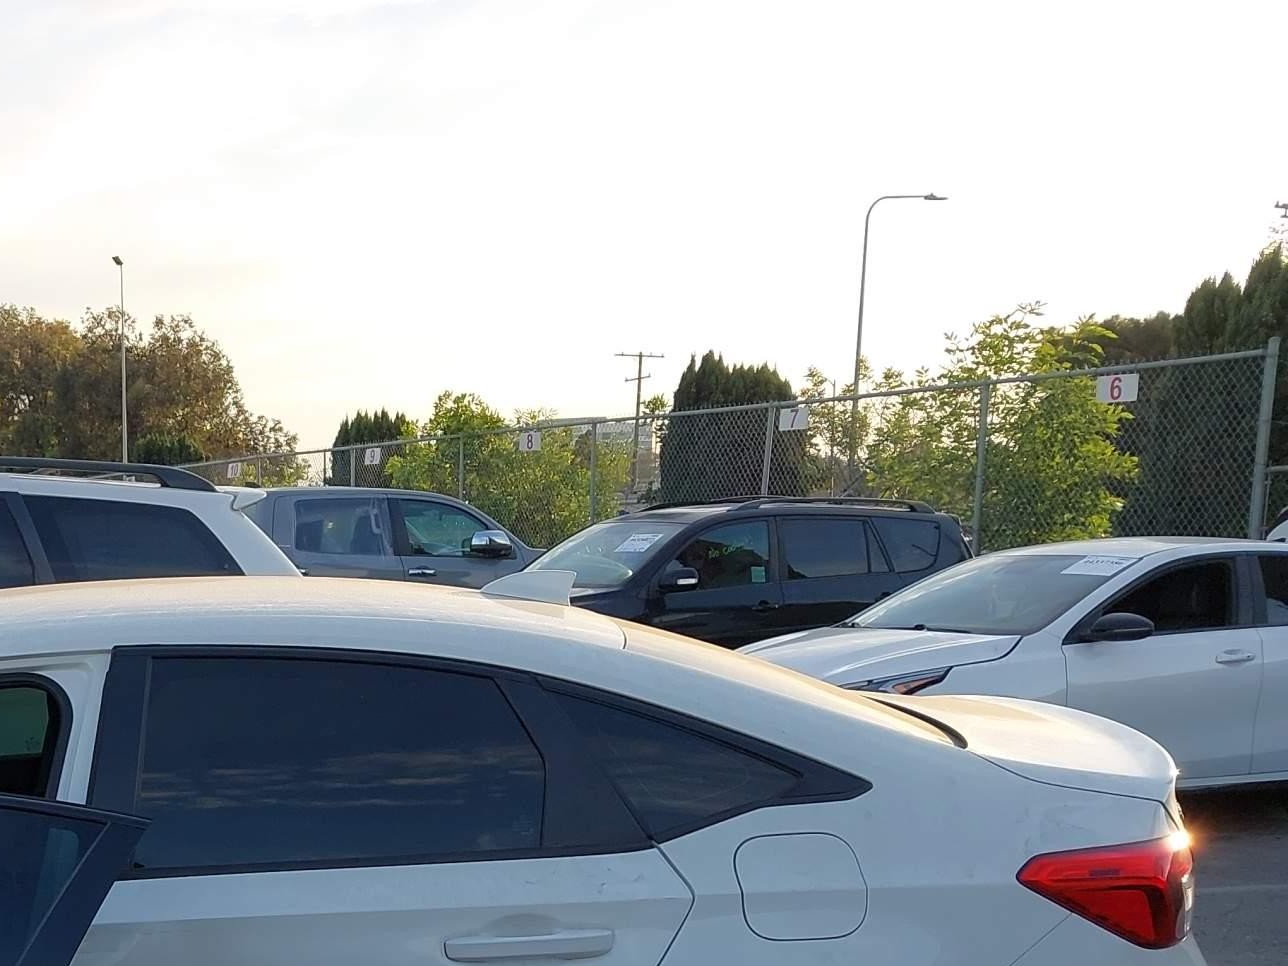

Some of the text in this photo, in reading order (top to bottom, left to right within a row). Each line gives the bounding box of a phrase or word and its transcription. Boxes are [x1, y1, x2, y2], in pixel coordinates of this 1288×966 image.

[1110, 376, 1122, 401] 6
[790, 408, 800, 429] 7
[527, 433, 534, 450] 8
[370, 449, 376, 463] 9
[230, 464, 239, 476] 10
